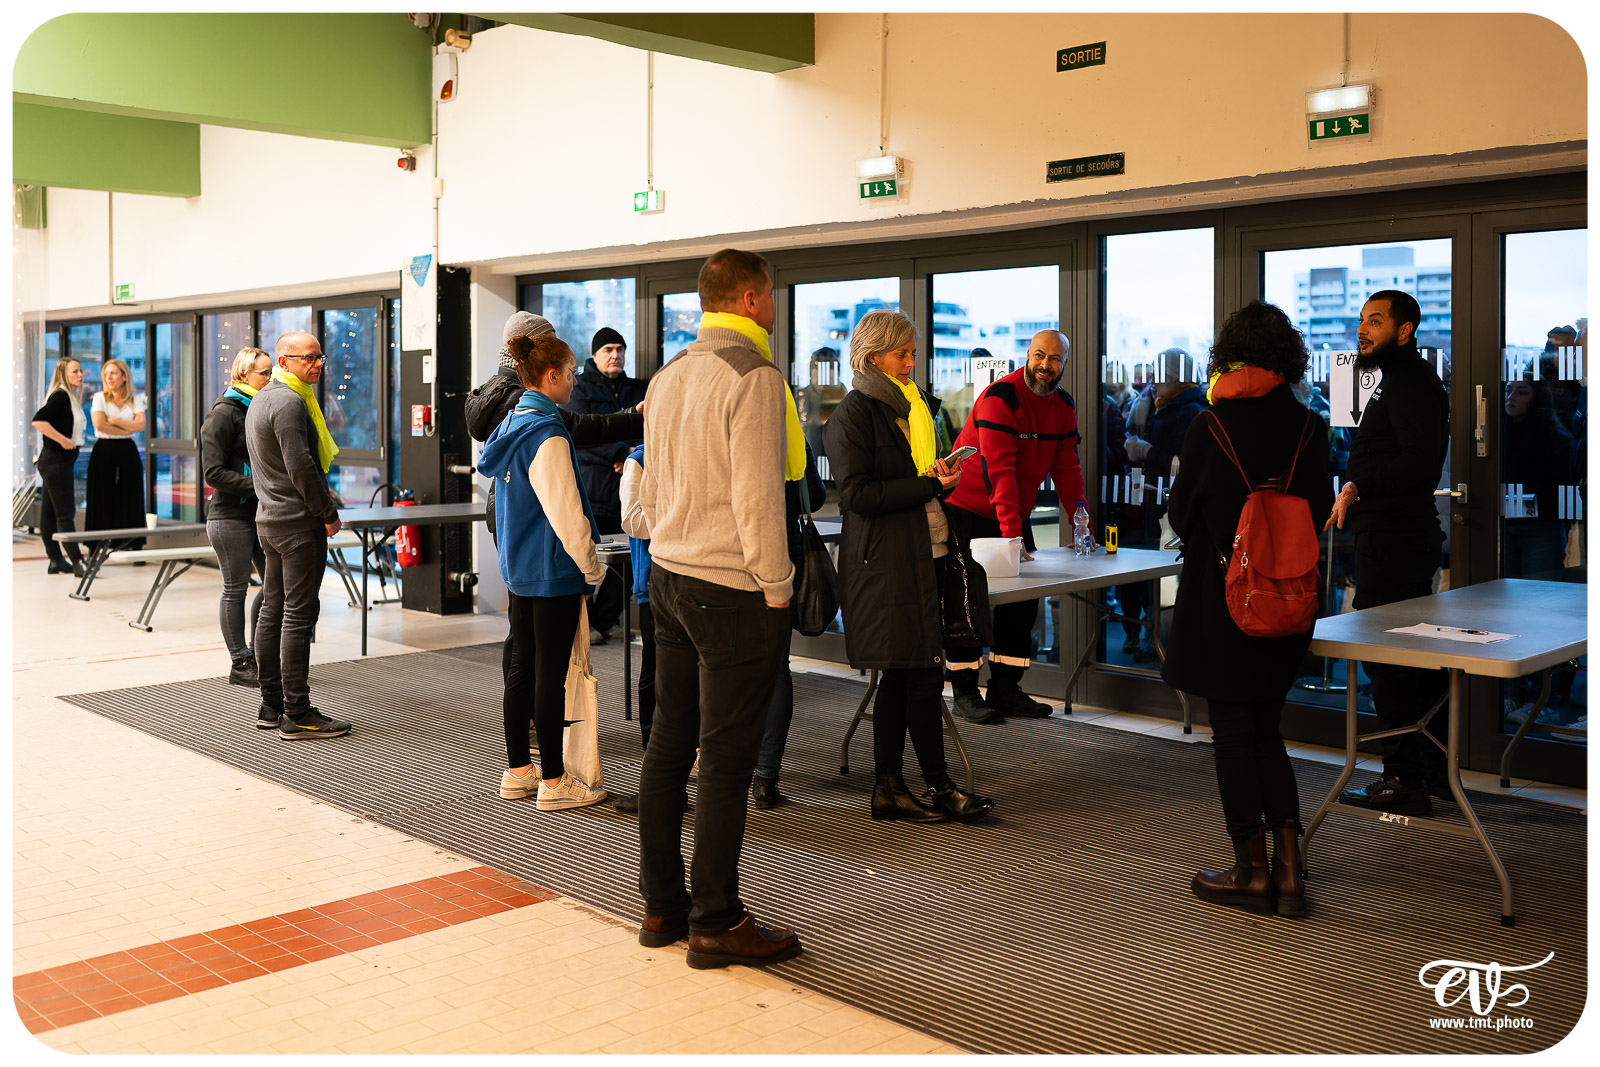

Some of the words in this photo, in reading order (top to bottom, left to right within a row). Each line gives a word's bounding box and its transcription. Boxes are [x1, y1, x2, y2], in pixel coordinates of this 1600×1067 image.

[1061, 47, 1102, 66] SORTIE
[1049, 165, 1073, 177] SORTIE
[1076, 164, 1085, 173] DE
[1088, 160, 1120, 172] SECOURS
[976, 359, 1007, 370] ENTREE
[1336, 352, 1359, 367] ENT
